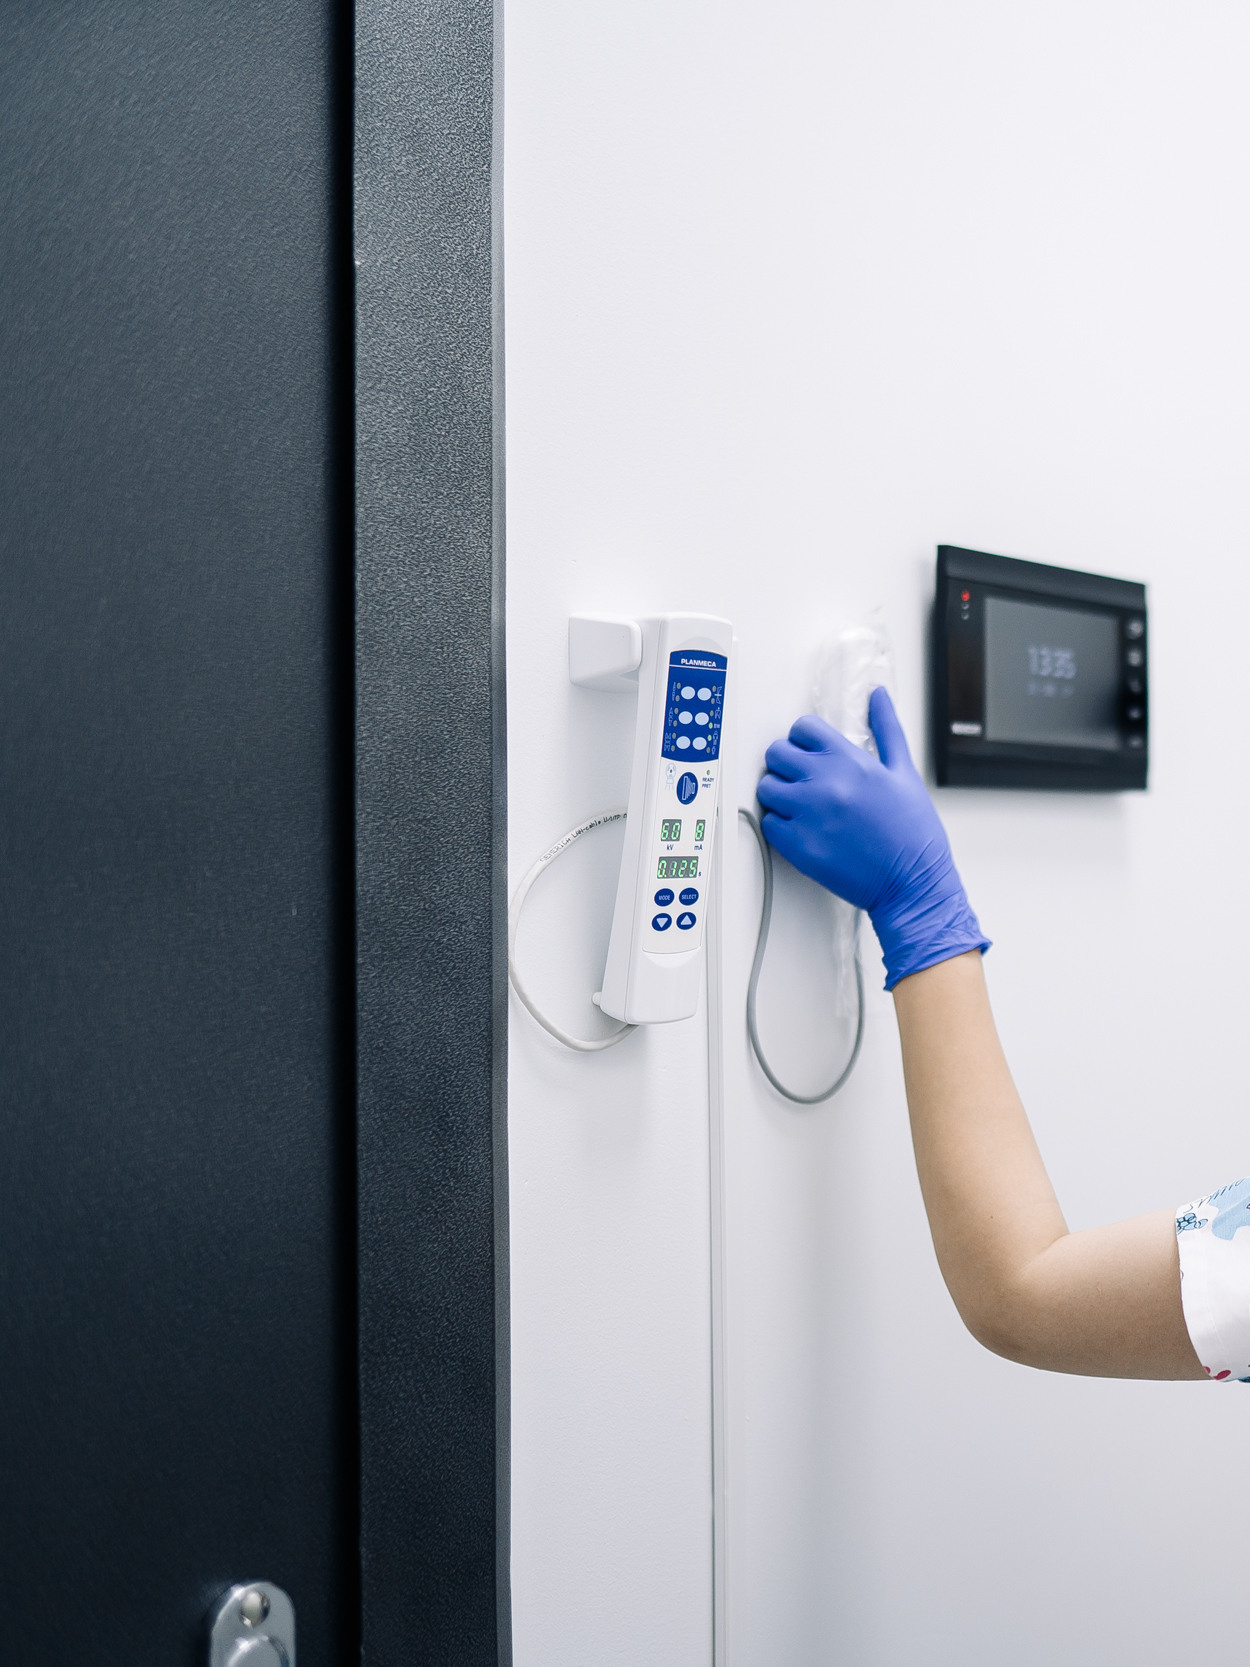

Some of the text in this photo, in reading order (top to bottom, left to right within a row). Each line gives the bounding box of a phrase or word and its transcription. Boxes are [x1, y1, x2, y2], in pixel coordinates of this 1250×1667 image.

[680, 658, 717, 668] PLANMECA
[661, 822, 680, 840] 60
[695, 822, 704, 840] 8
[657, 859, 697, 878] 0.125
